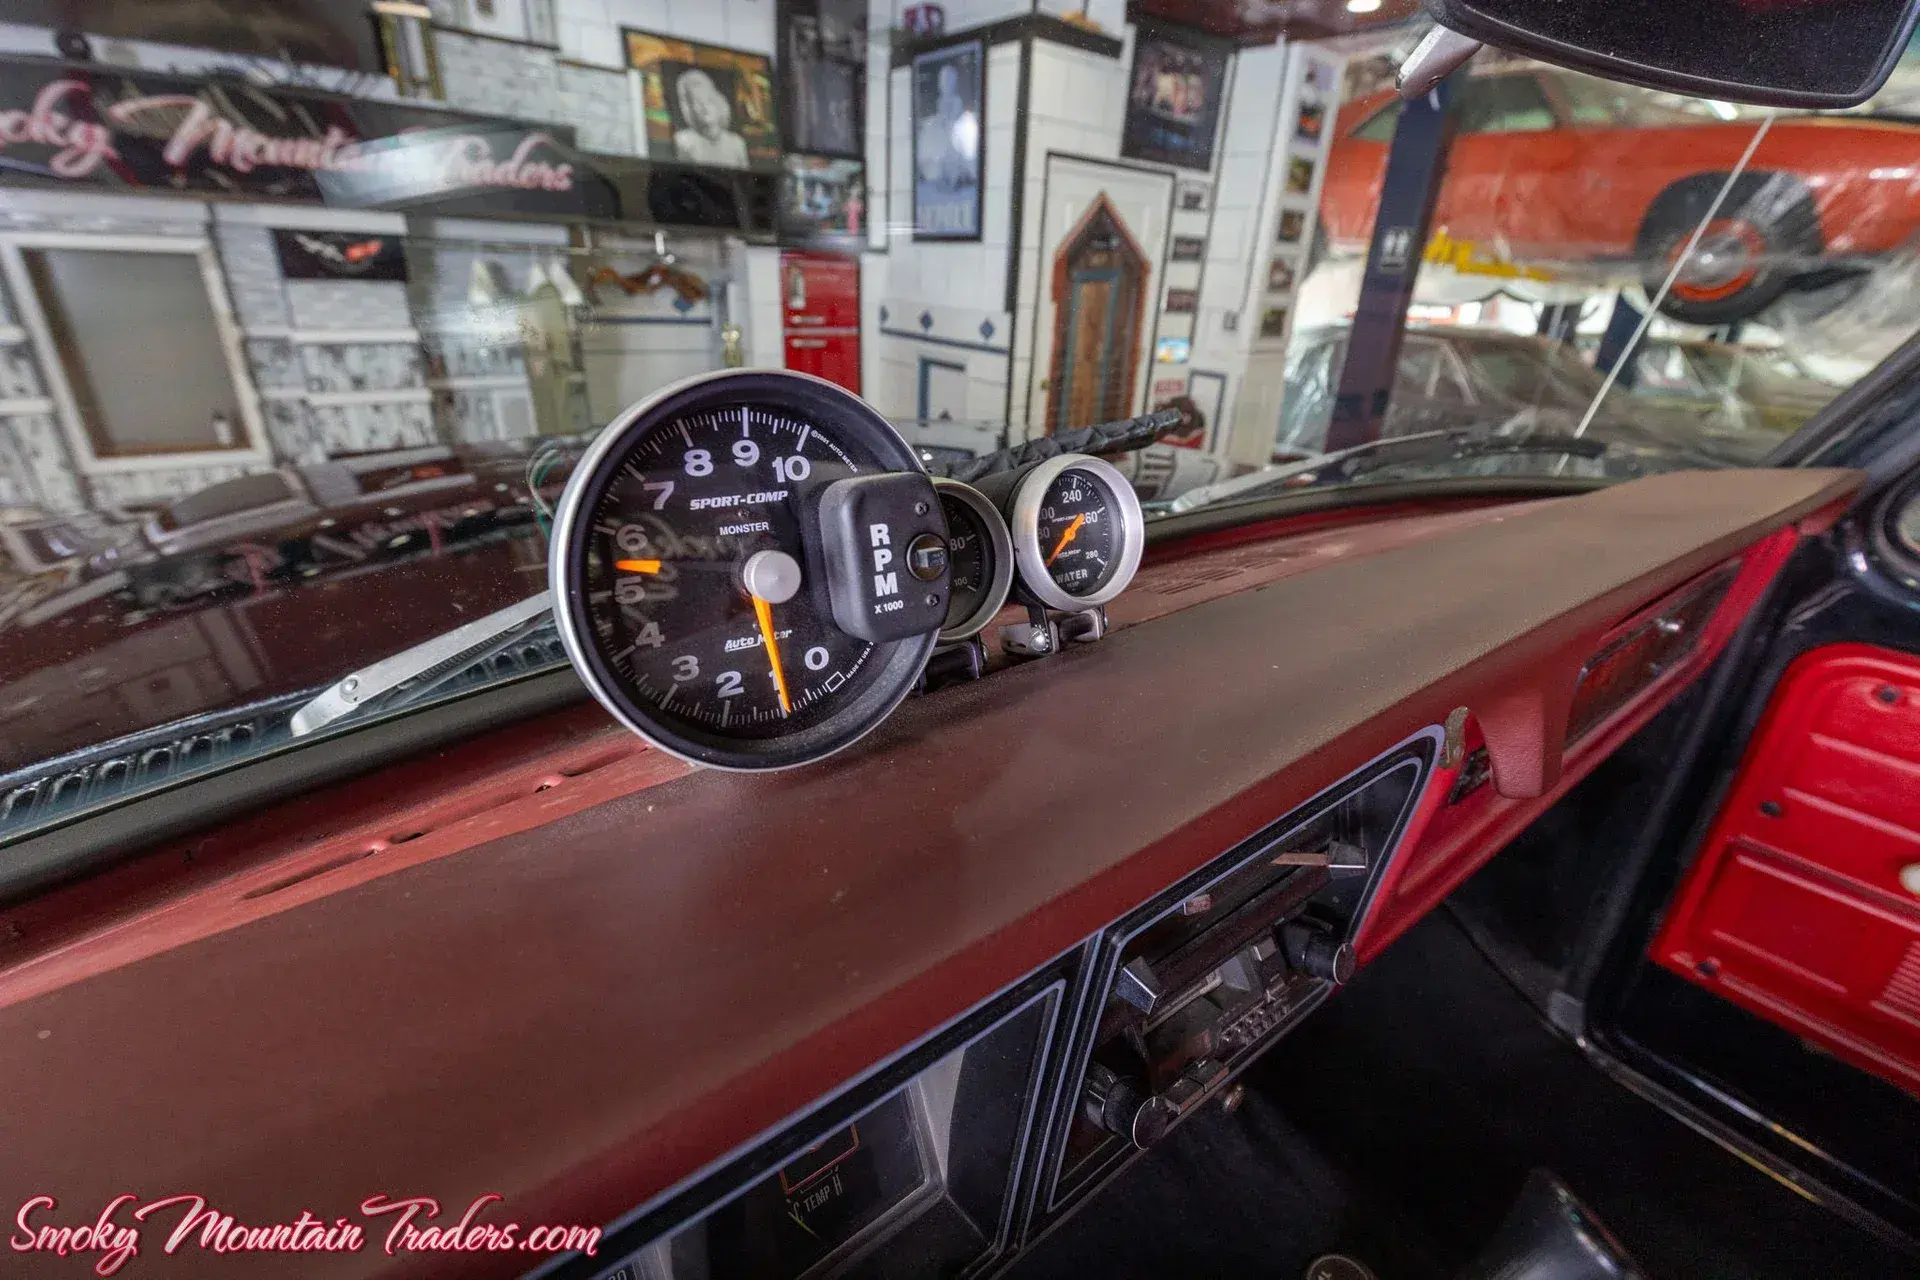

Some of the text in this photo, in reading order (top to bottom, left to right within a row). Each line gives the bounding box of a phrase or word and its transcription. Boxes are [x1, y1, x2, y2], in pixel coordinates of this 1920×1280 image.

[684, 449, 714, 477] 8
[732, 440, 760, 467] 9
[829, 443, 843, 457] AUTO
[842, 455, 858, 473] METER
[772, 455, 811, 483] 10
[643, 481, 675, 510] 7
[690, 491, 788, 511] SPORT-COMP
[1062, 490, 1082, 503] 240
[616, 524, 648, 551] 6
[719, 522, 770, 536] MONSTER
[950, 537, 965, 551] 80
[1086, 550, 1098, 559] 280
[954, 577, 968, 586] 100
[1056, 569, 1088, 584] WATER
[614, 576, 646, 604] 5
[874, 600, 904, 614] X 1000
[635, 622, 665, 648] 4
[724, 636, 755, 652] Auto
[671, 655, 700, 682] 3
[805, 647, 830, 671] 0
[846, 664, 859, 679] MADE
[857, 658, 863, 666] IN
[861, 647, 871, 659] USA
[716, 671, 744, 698] 2
[803, 1185, 830, 1212] TEMP
